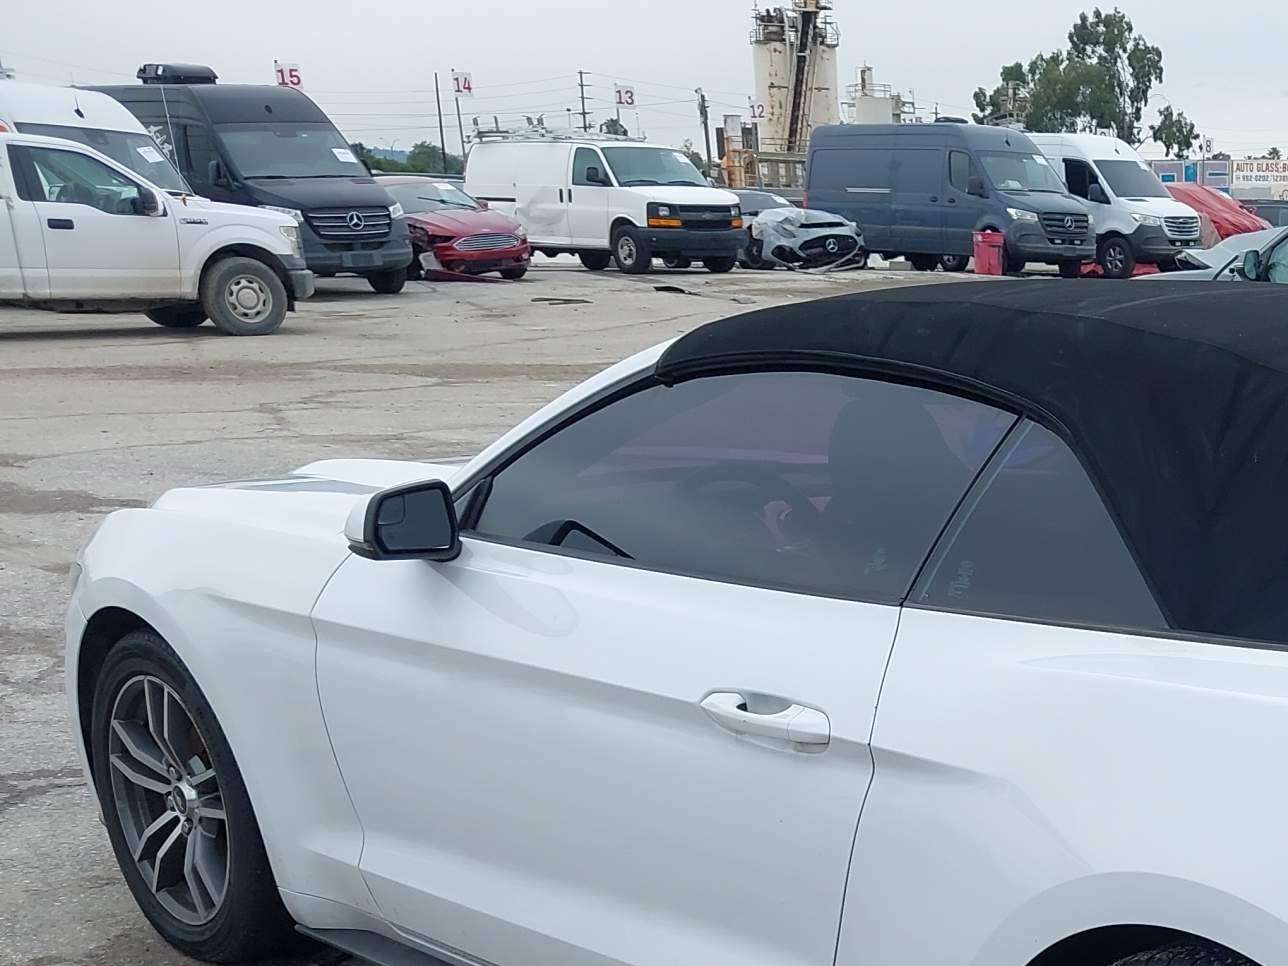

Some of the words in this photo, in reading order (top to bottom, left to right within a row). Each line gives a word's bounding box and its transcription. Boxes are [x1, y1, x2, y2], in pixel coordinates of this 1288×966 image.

[276, 68, 301, 86] 15
[453, 76, 472, 93] 14
[615, 89, 635, 105] 13
[750, 104, 765, 118] 12
[1205, 139, 1211, 153] 8
[1235, 163, 1254, 173] AUTO
